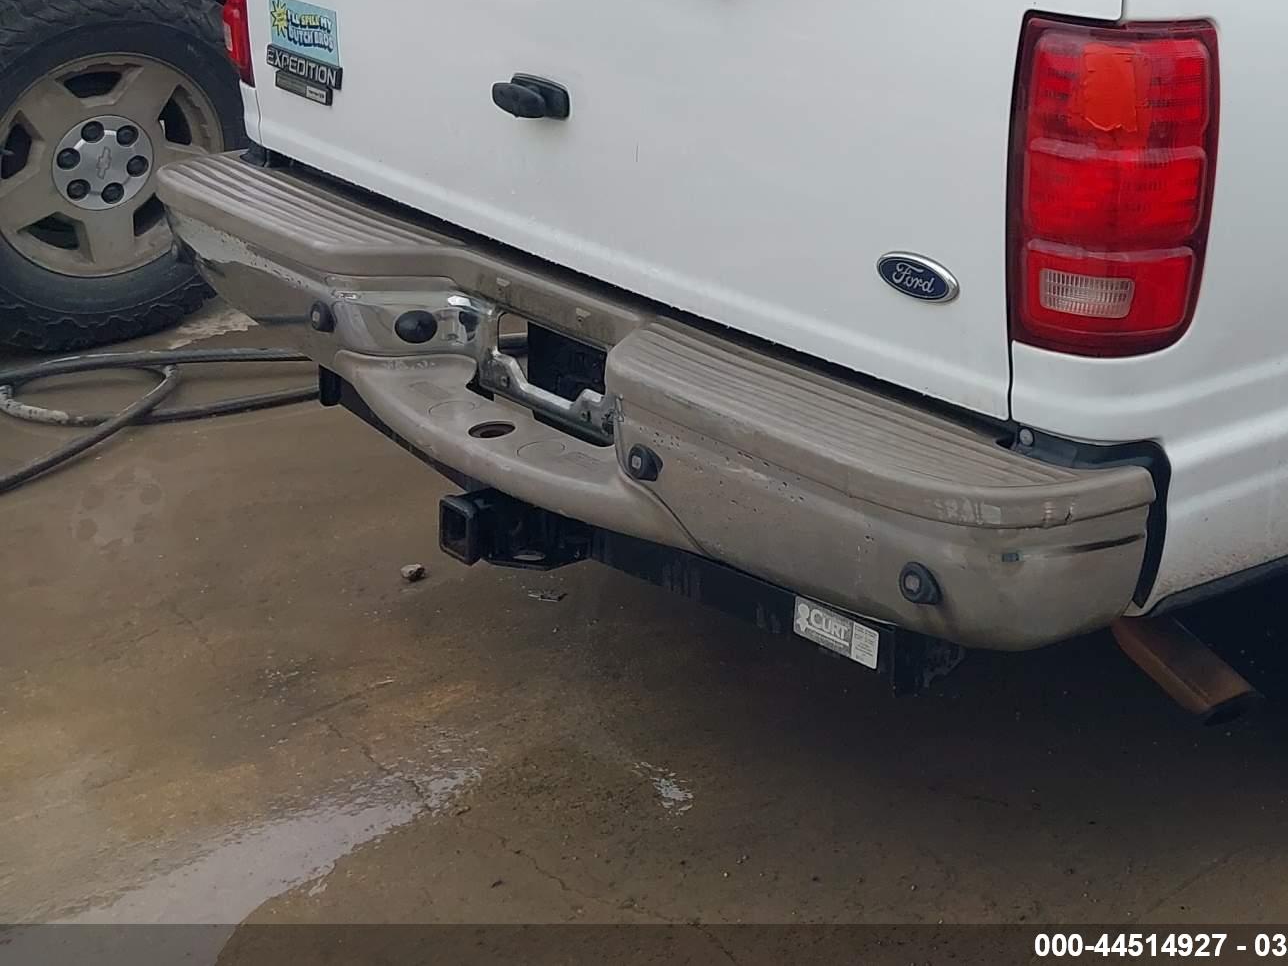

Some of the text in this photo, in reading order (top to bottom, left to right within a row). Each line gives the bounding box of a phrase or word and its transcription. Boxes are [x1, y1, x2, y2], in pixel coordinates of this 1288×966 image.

[287, 25, 314, 45] DUTCH
[319, 16, 333, 33] MY
[267, 49, 338, 88] EXPEDITION
[892, 262, 935, 293] Ford
